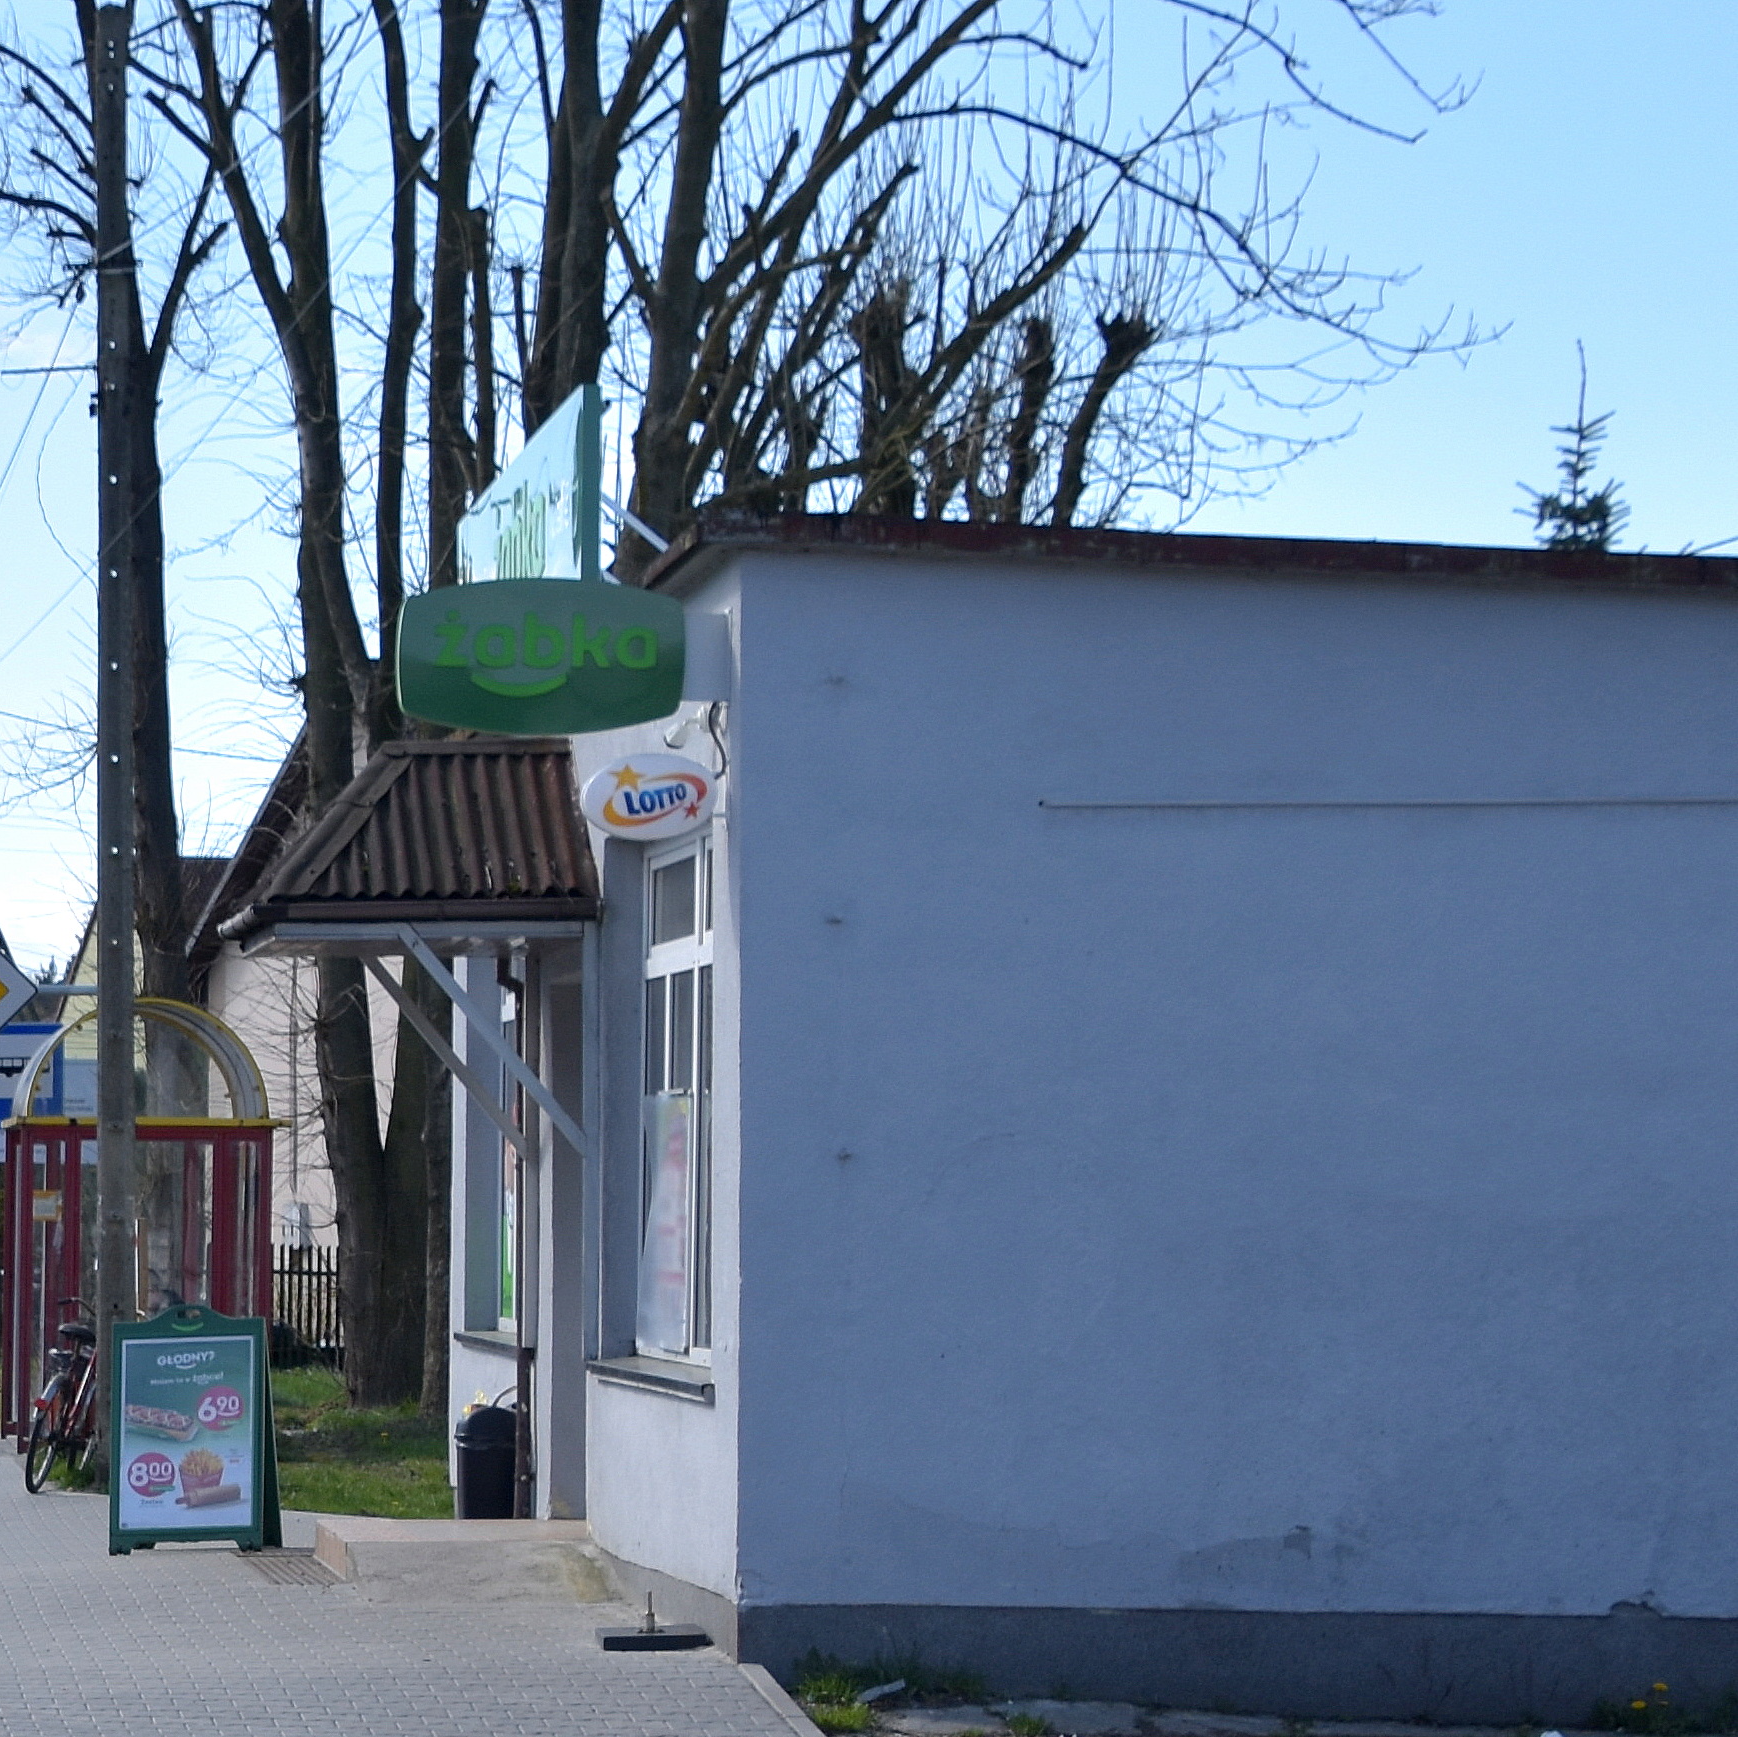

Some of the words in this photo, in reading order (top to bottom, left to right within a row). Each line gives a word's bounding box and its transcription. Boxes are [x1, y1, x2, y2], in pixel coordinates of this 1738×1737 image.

[435, 610, 659, 670] żabka
[624, 783, 687, 815] LOTTO
[157, 1350, 215, 1367] GŁODNY?
